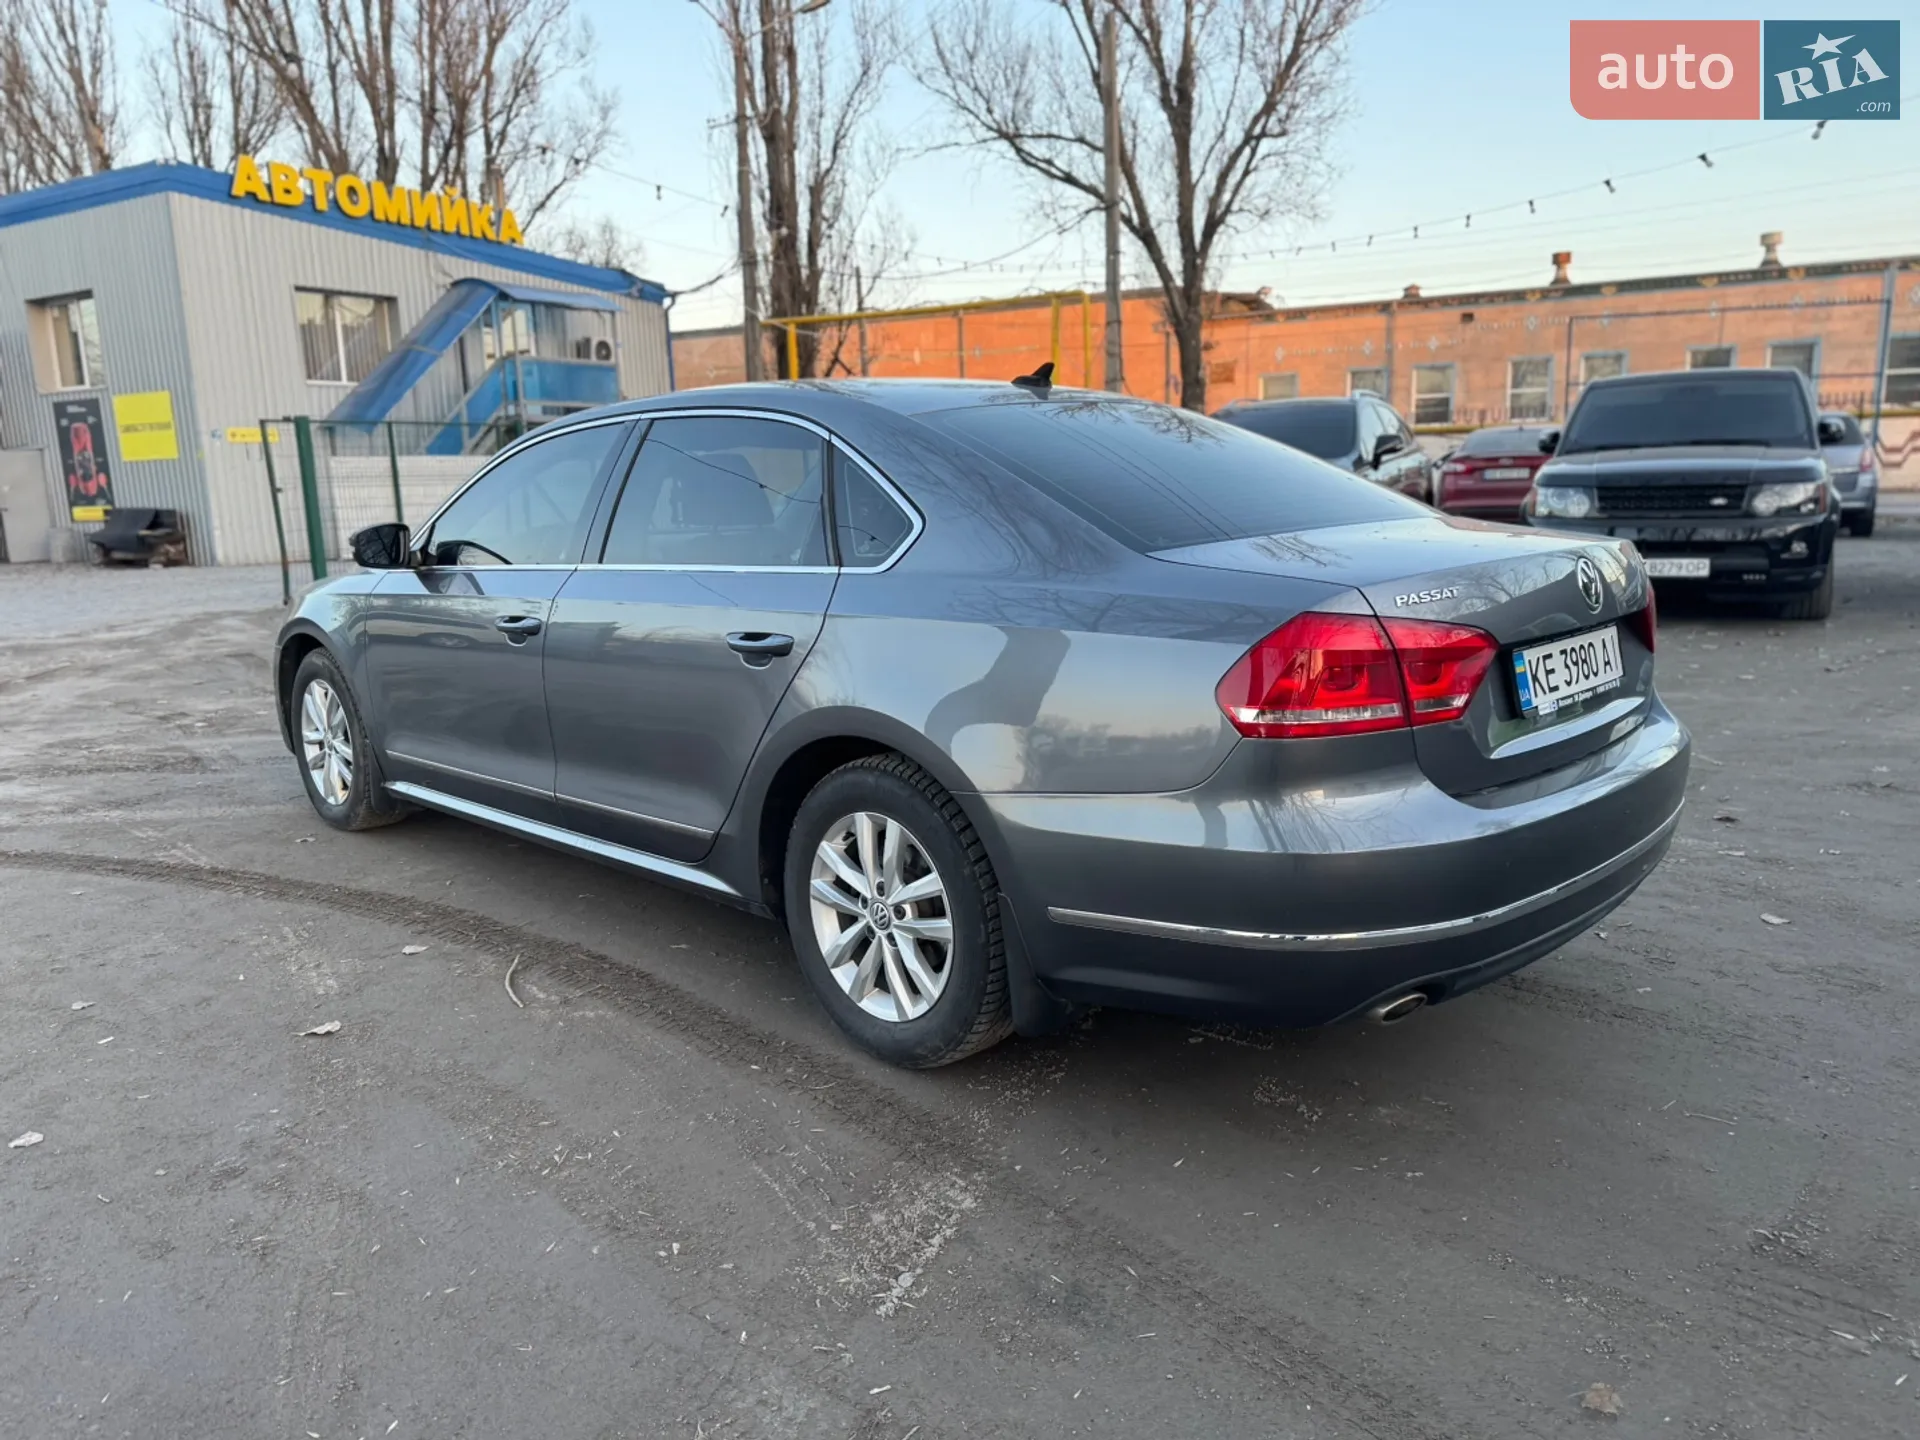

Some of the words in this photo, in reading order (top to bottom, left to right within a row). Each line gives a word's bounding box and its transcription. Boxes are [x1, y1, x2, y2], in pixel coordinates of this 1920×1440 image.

[231, 154, 524, 245] АВТОМИЙКА
[1394, 586, 1460, 607] PASSAT
[1528, 652, 1560, 698] KE
[1559, 641, 1599, 687] 3980
[1519, 688, 1530, 701] UA
